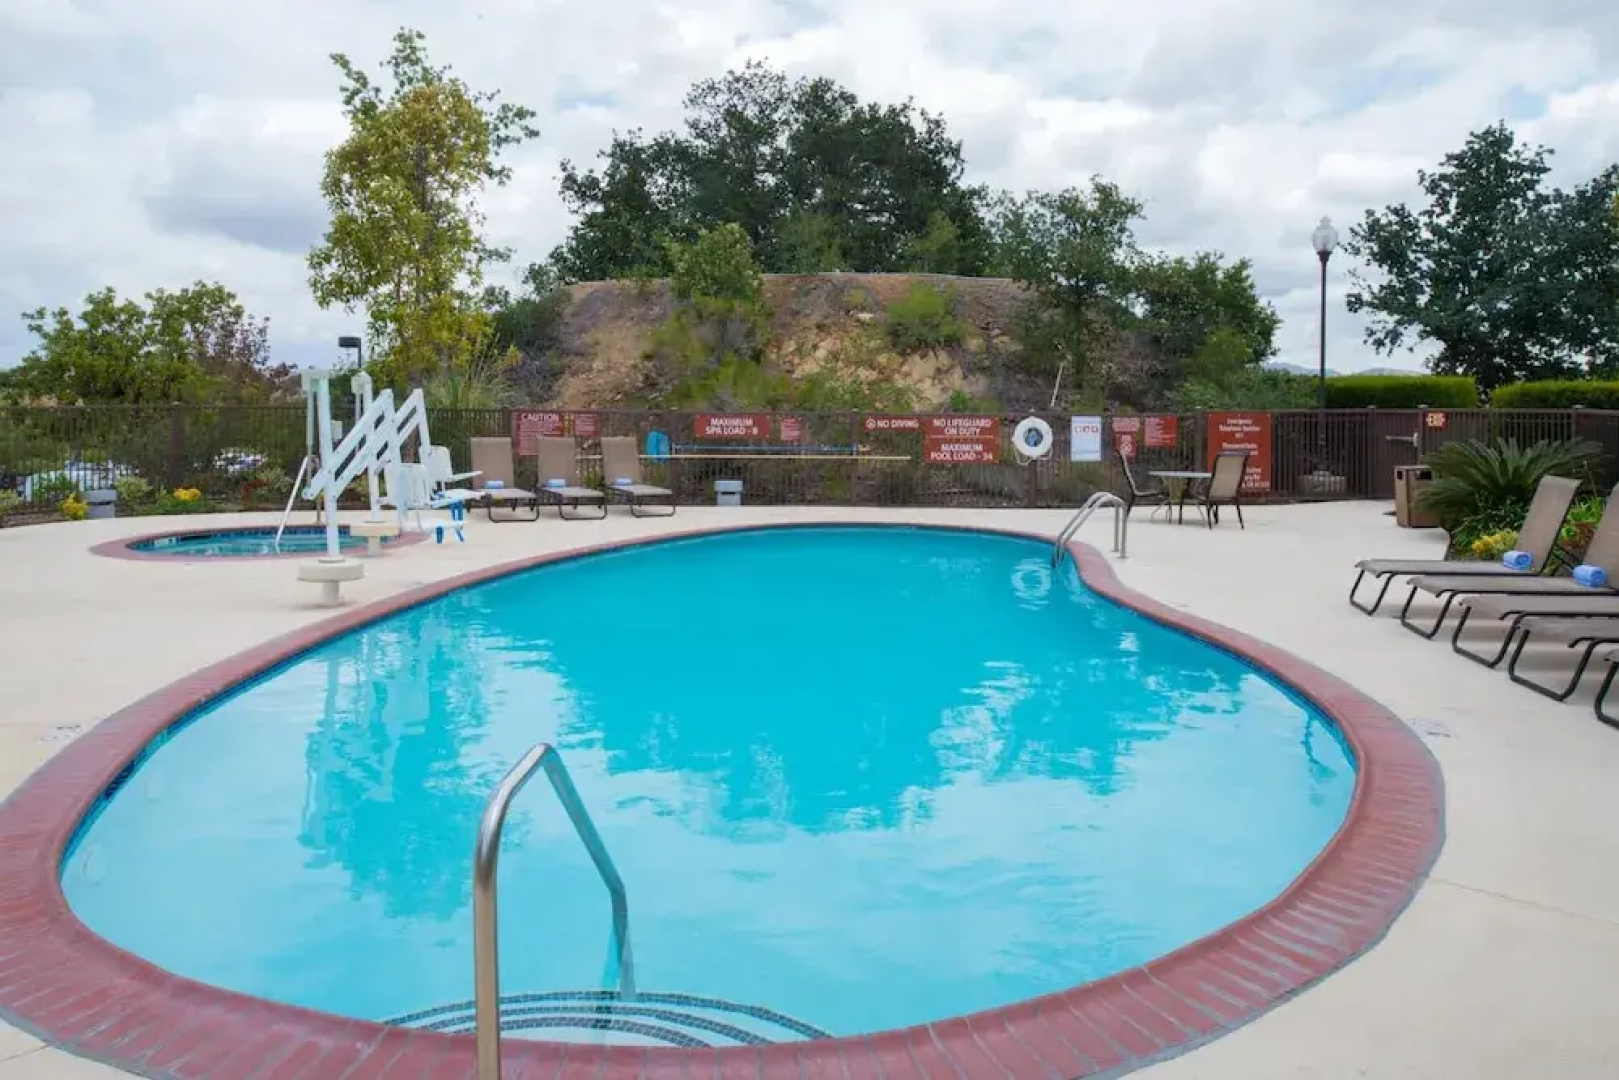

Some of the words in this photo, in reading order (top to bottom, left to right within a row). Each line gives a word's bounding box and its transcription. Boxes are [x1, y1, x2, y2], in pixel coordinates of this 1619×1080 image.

[521, 412, 561, 421] CAUTION
[710, 418, 753, 426] MAXIMUM
[877, 420, 889, 428] NO
[891, 420, 919, 428] DIVING
[933, 419, 946, 427] NO
[947, 419, 992, 427] LIFEGUARD
[705, 426, 722, 434] SPA
[723, 426, 746, 434] LOAD
[944, 427, 957, 435] ON
[959, 427, 980, 435] DUTY
[940, 443, 983, 451] MAXIMUM
[931, 452, 952, 460] POOL
[953, 452, 976, 460] LOAD
